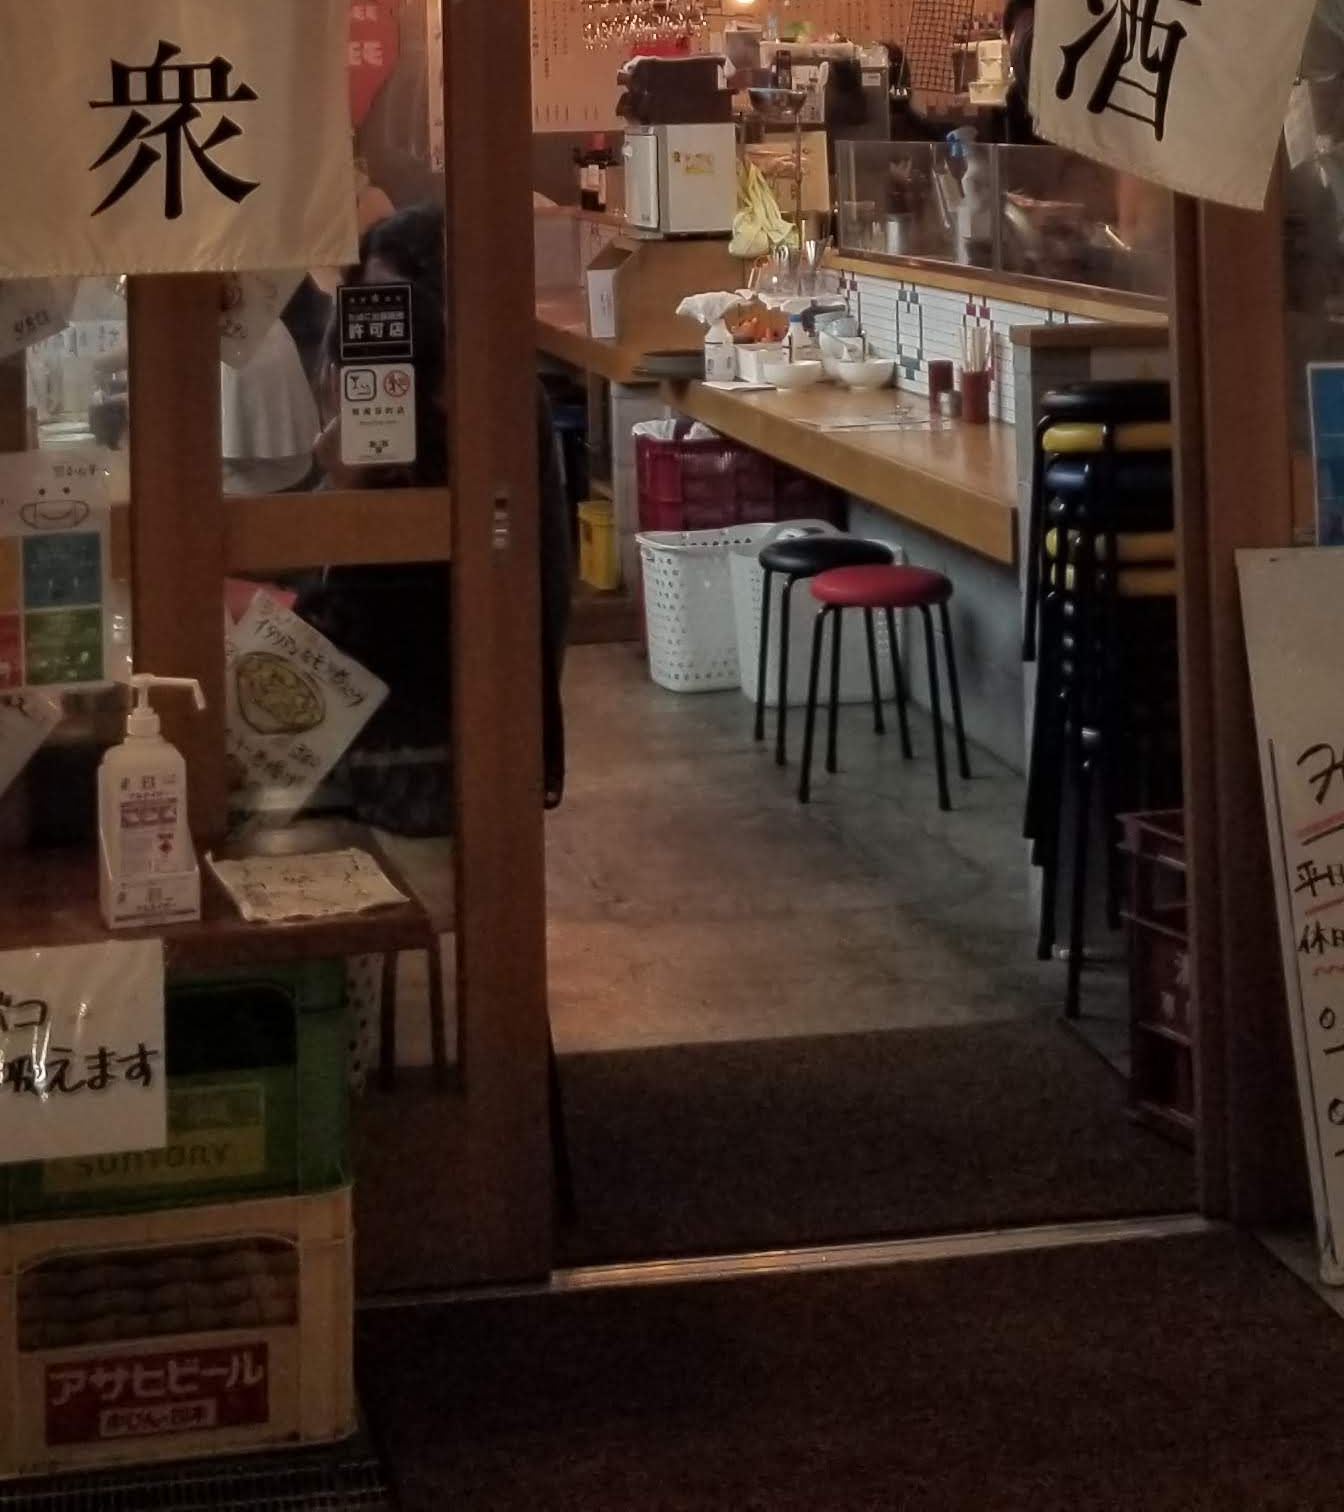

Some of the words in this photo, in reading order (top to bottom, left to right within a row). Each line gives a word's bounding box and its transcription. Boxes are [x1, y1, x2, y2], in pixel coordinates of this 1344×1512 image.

[50, 1352, 264, 1405] アサヒビール
